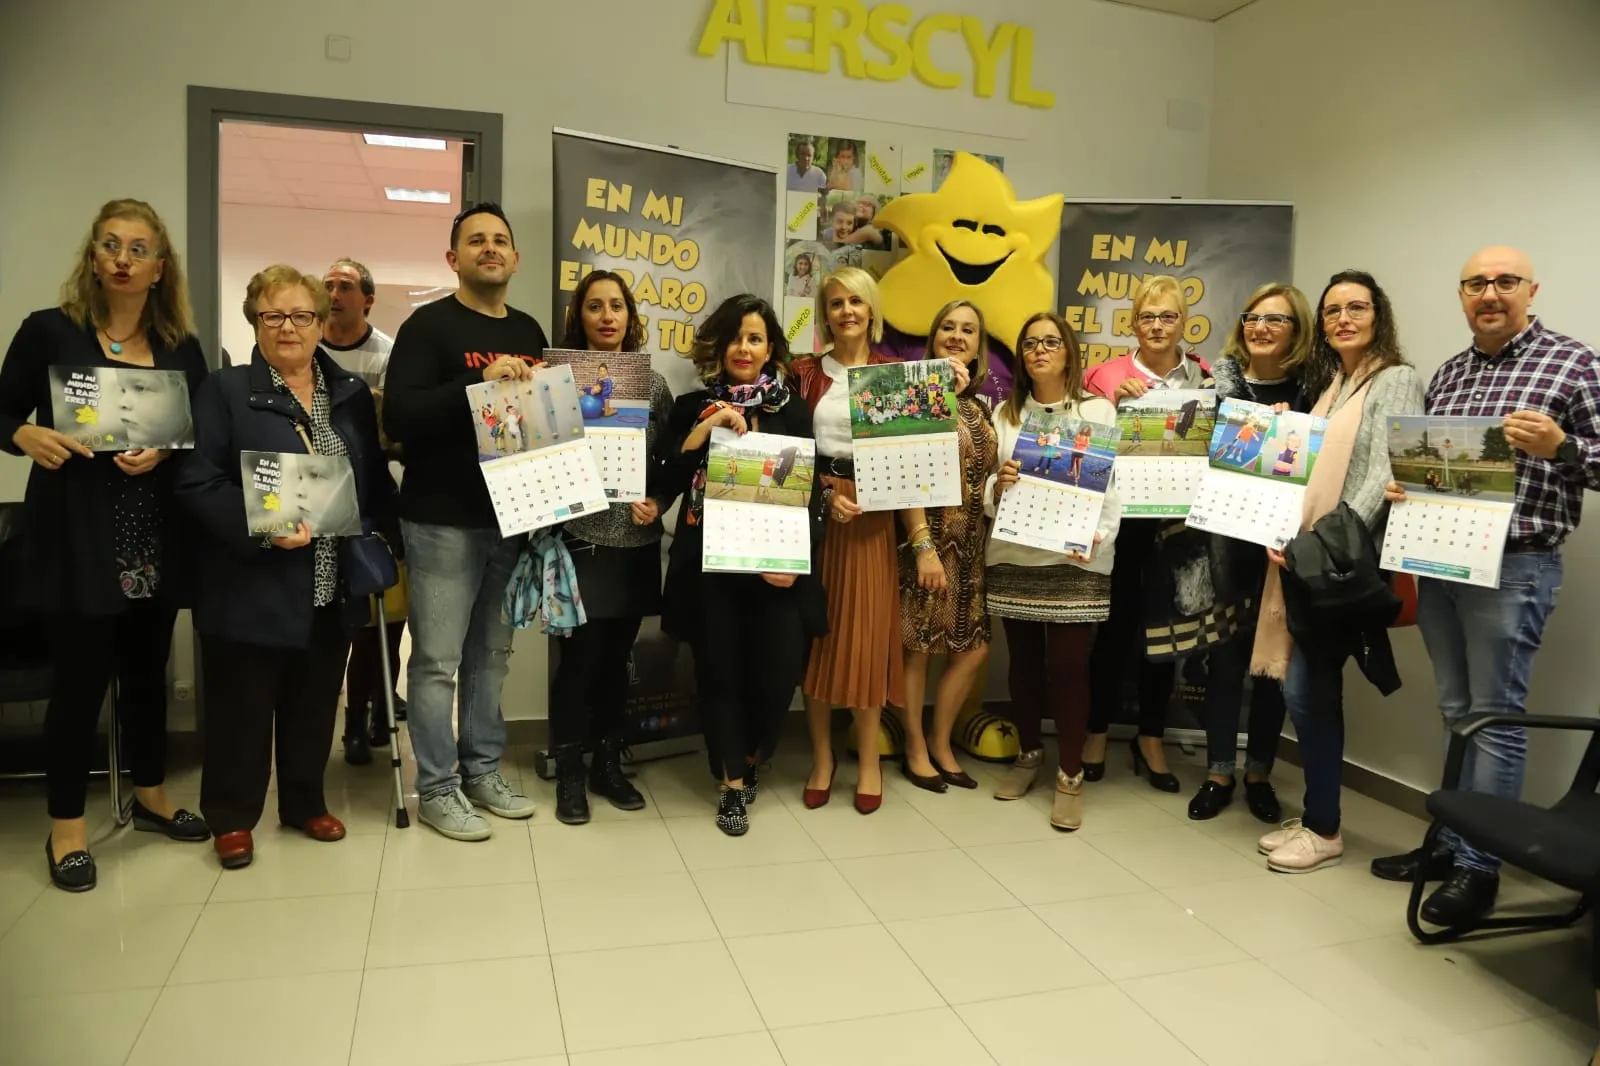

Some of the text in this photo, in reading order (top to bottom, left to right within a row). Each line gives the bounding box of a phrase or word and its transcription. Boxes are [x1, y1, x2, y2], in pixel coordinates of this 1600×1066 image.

[697, 0, 1056, 109] AERSCYL
[586, 177, 684, 226] EN MI
[571, 217, 700, 271] MUNDO
[1090, 234, 1188, 268] EN MI
[559, 260, 594, 291] E
[1077, 268, 1204, 306] MUNO
[658, 316, 697, 353] TÚ
[1065, 305, 1211, 344] EL RO
[254, 519, 285, 533] 2020
